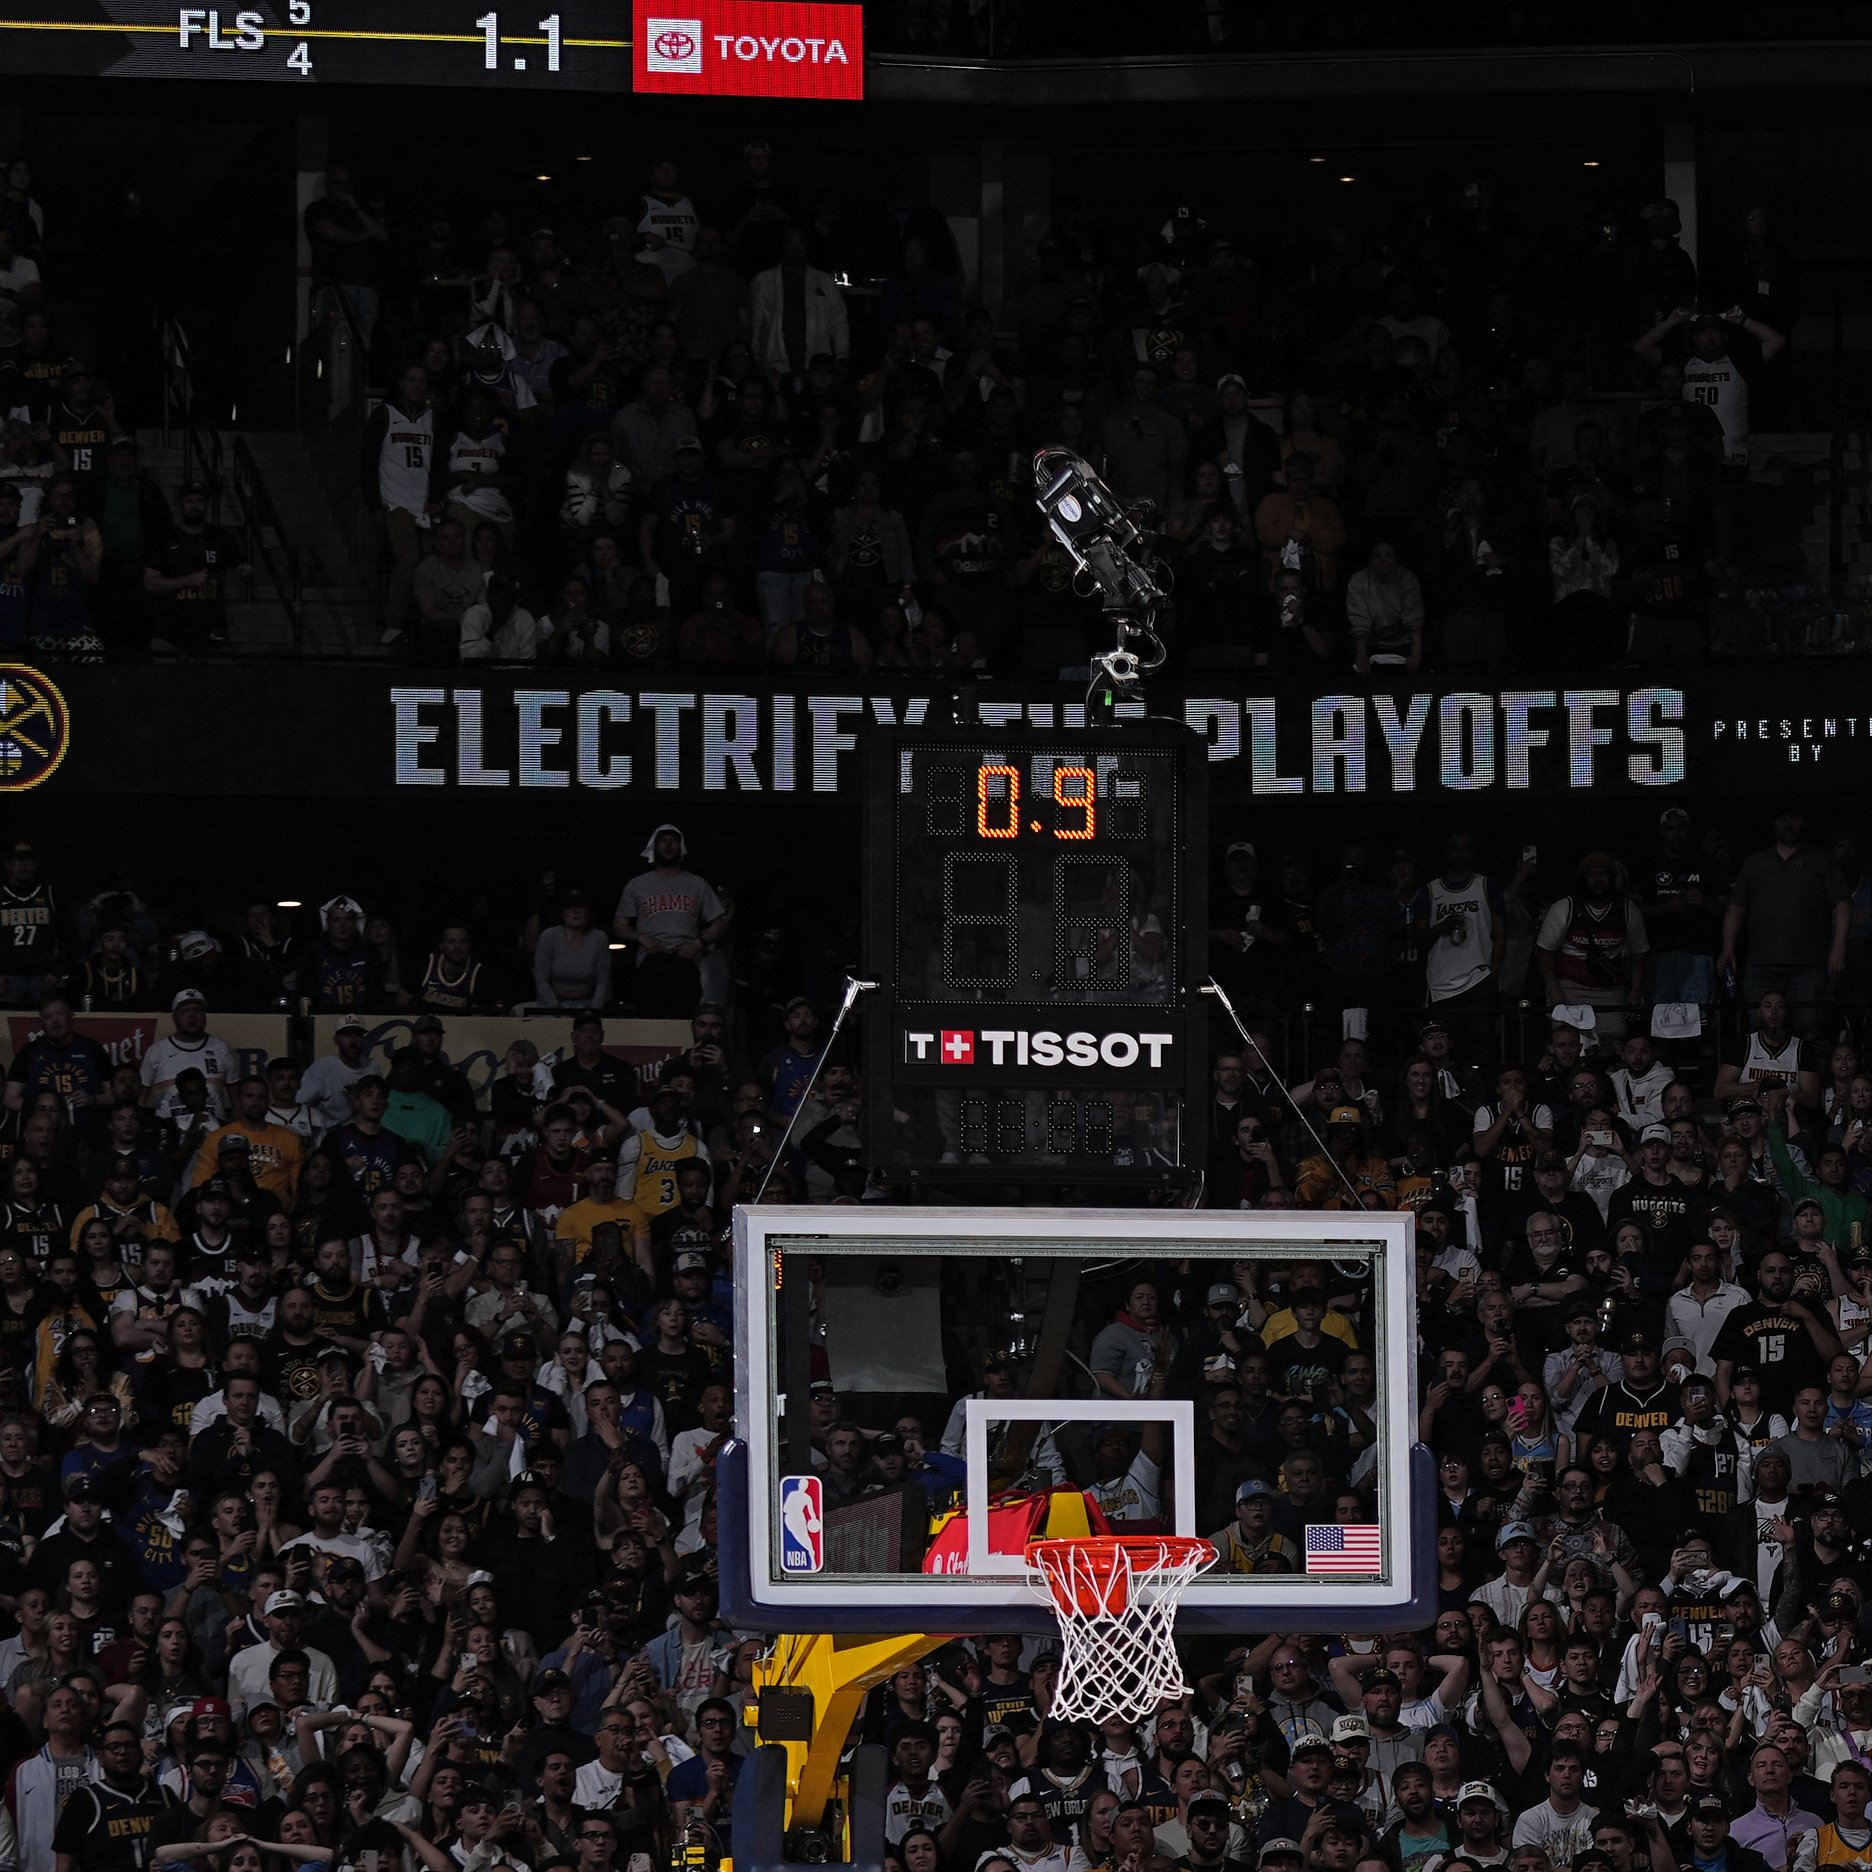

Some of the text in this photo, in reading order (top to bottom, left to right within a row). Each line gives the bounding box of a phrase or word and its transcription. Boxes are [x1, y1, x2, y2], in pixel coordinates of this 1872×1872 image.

[178, 8, 264, 52] FLS
[475, 12, 562, 72] 1.1
[714, 34, 849, 66] TOYOTA
[287, 41, 312, 76] 4
[1693, 386, 1719, 404] 50
[60, 431, 106, 447] DENVER
[74, 447, 93, 471] 15
[403, 446, 425, 469] 15
[1665, 544, 1681, 560] 15
[1185, 688, 1686, 795] PLAYOFFS
[1790, 742, 1823, 763] BY
[978, 766, 1094, 839] 0.9
[1436, 900, 1479, 915] LAKERS
[13, 924, 36, 947] 27
[981, 1031, 1172, 1067] TISSOT
[56, 1075, 72, 1092] 15
[1503, 1165, 1521, 1191] 15
[660, 1178, 677, 1205] 3
[1632, 1201, 1686, 1214] NUGGETS
[33, 1235, 51, 1256] 15
[121, 1242, 142, 1264] 15
[1744, 1318, 1801, 1337] DENVER
[1757, 1335, 1786, 1365] 15
[1615, 1411, 1669, 1428] DENVER
[1715, 1456, 1736, 1476] 27
[788, 1553, 808, 1567] NBA
[1688, 1622, 1713, 1655] 15
[892, 1801, 944, 1817] DENVER
